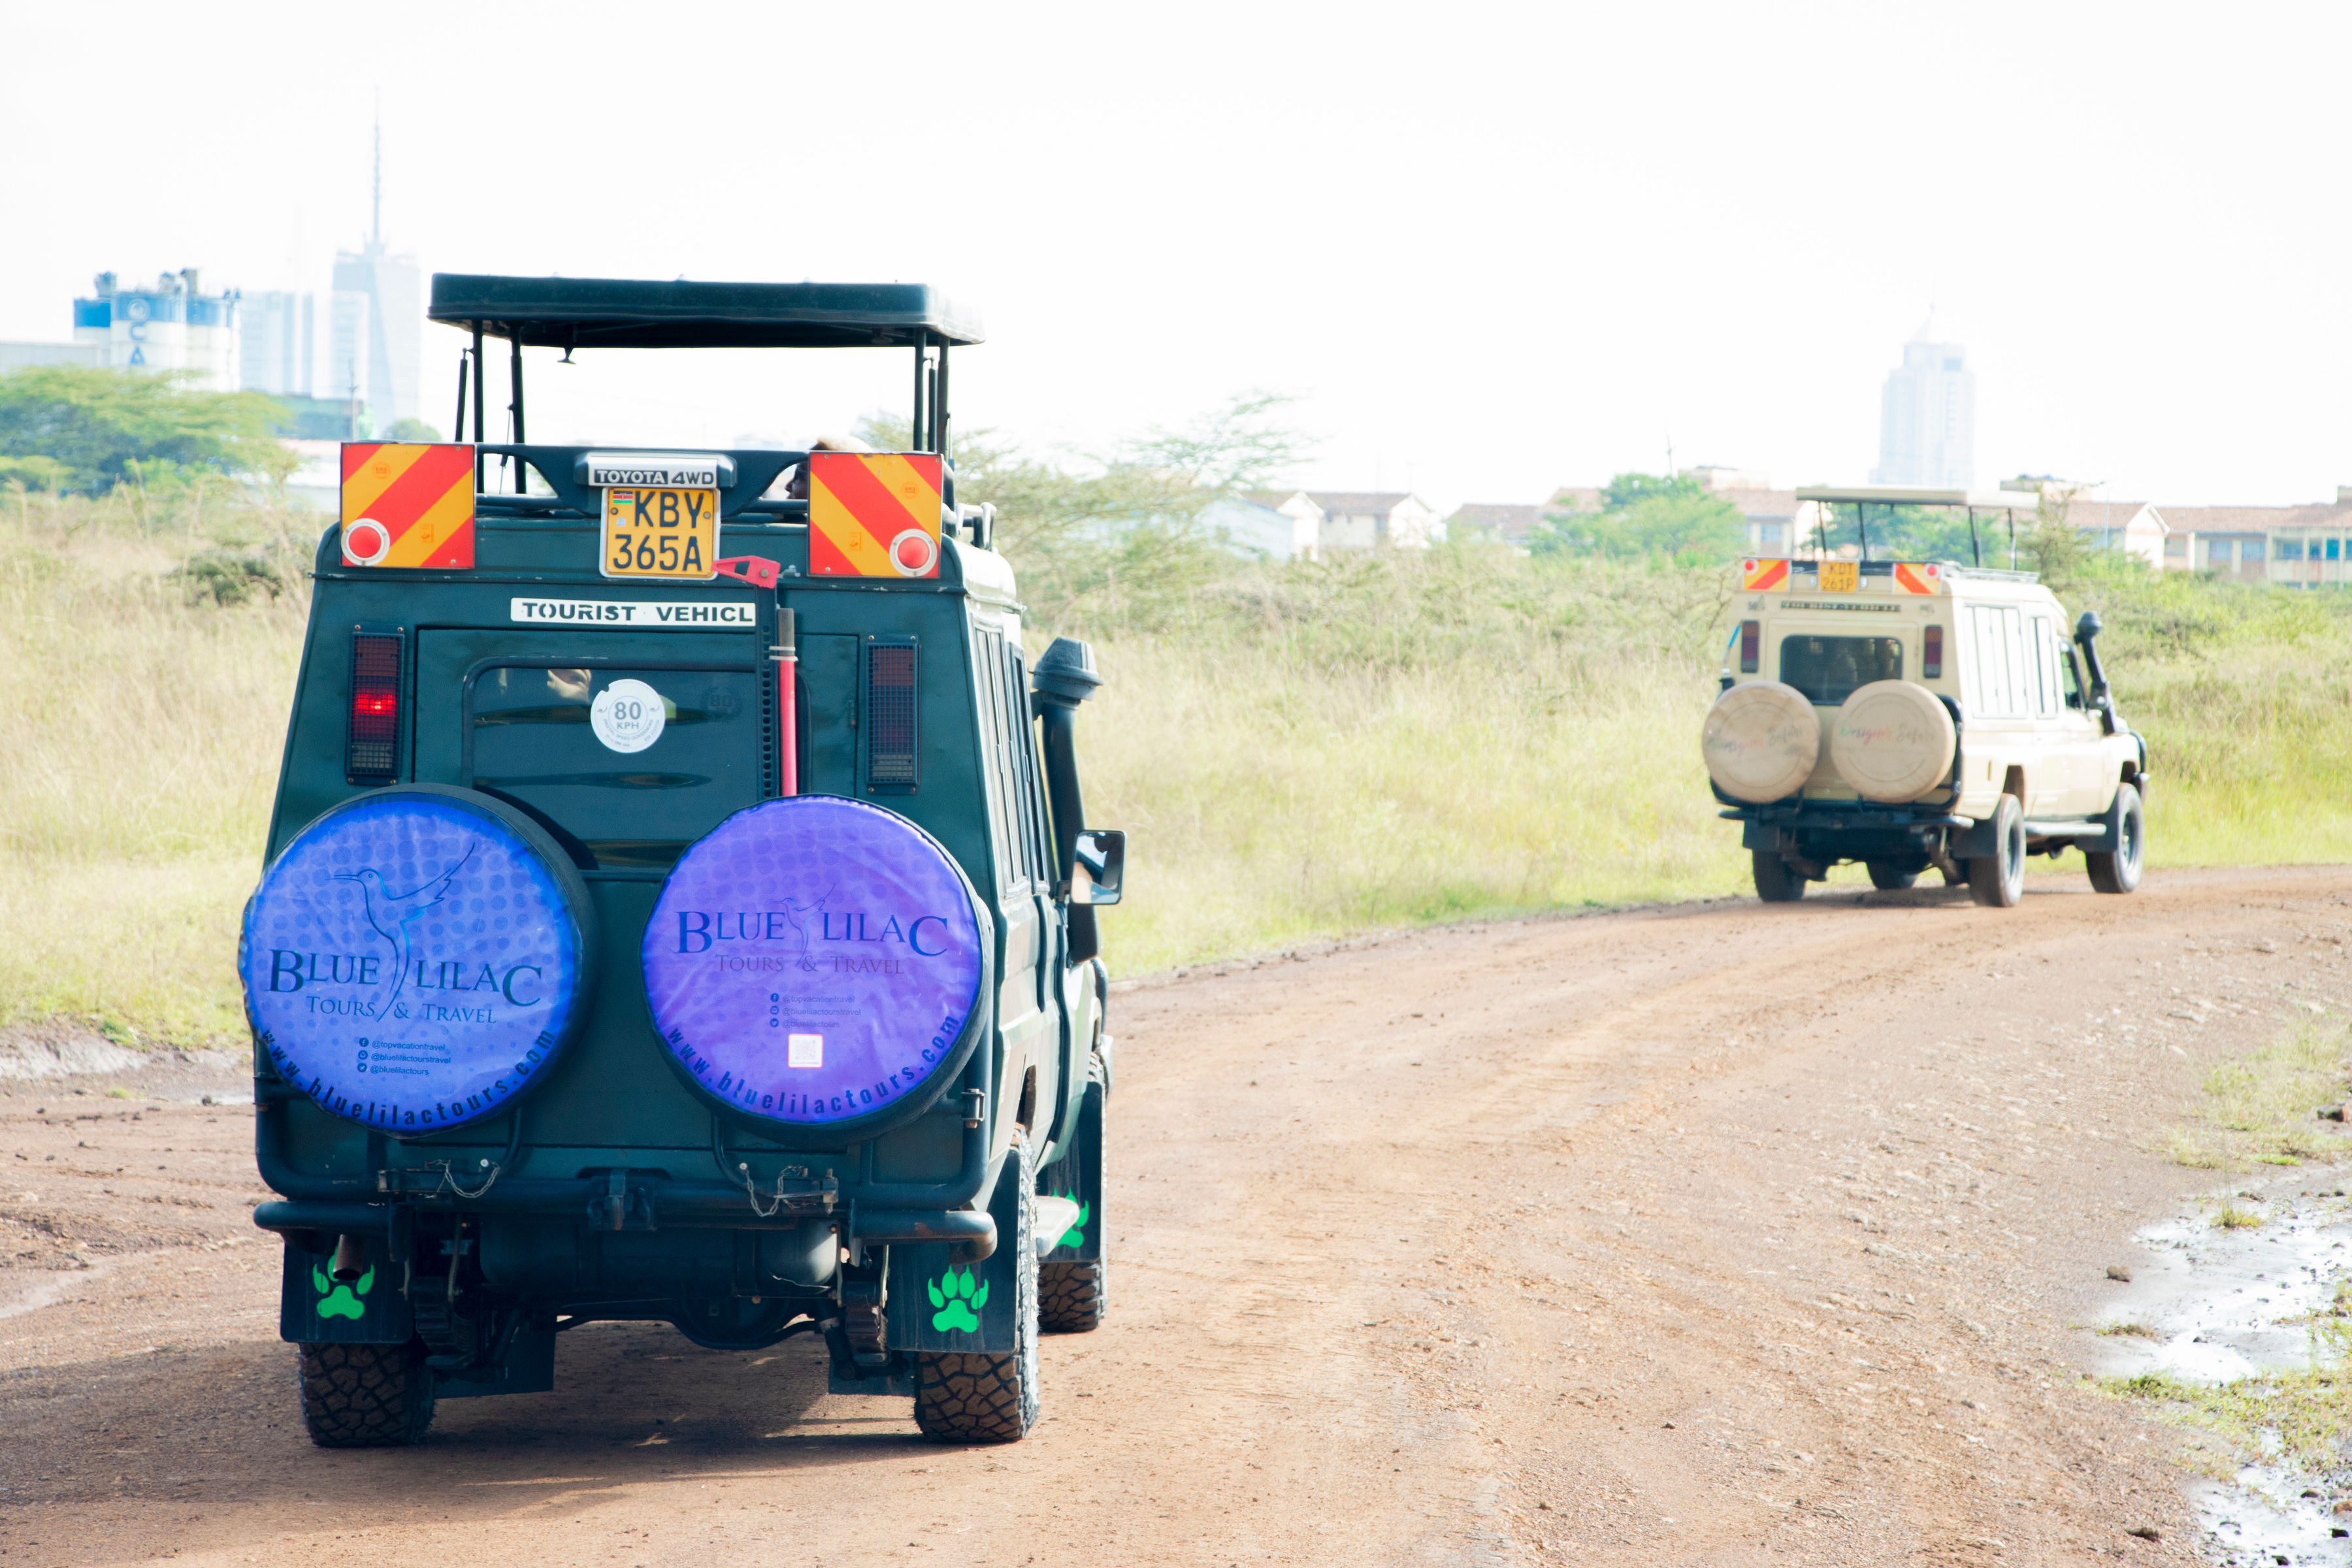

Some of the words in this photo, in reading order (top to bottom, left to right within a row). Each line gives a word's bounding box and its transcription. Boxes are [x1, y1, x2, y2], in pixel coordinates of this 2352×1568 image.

[596, 470, 666, 484] TOYOTA
[671, 471, 714, 485] 4WD
[634, 491, 704, 529] KBY
[613, 534, 702, 572] 365A
[522, 602, 636, 621] TOURIST
[656, 606, 753, 622] VEHICL
[614, 702, 642, 720] 80
[674, 911, 785, 955] BLUE
[820, 912, 949, 957] LILAC
[715, 955, 784, 973] TOURS
[802, 955, 818, 973] &
[830, 955, 905, 975] TRAVEL
[265, 949, 381, 993] BLUE
[416, 960, 542, 1007] LILAC
[306, 995, 376, 1017] TOURS
[393, 1002, 410, 1019] &
[422, 1002, 497, 1024] TRAVEL
[372, 1040, 446, 1051] @topvacationtravel
[370, 1065, 430, 1075] @bluelilactours
[371, 1053, 451, 1064] @bluelilactourstravel
[669, 1015, 959, 1115] www.bluelilactours.com
[261, 1028, 555, 1125] www.bluelilactours.com
